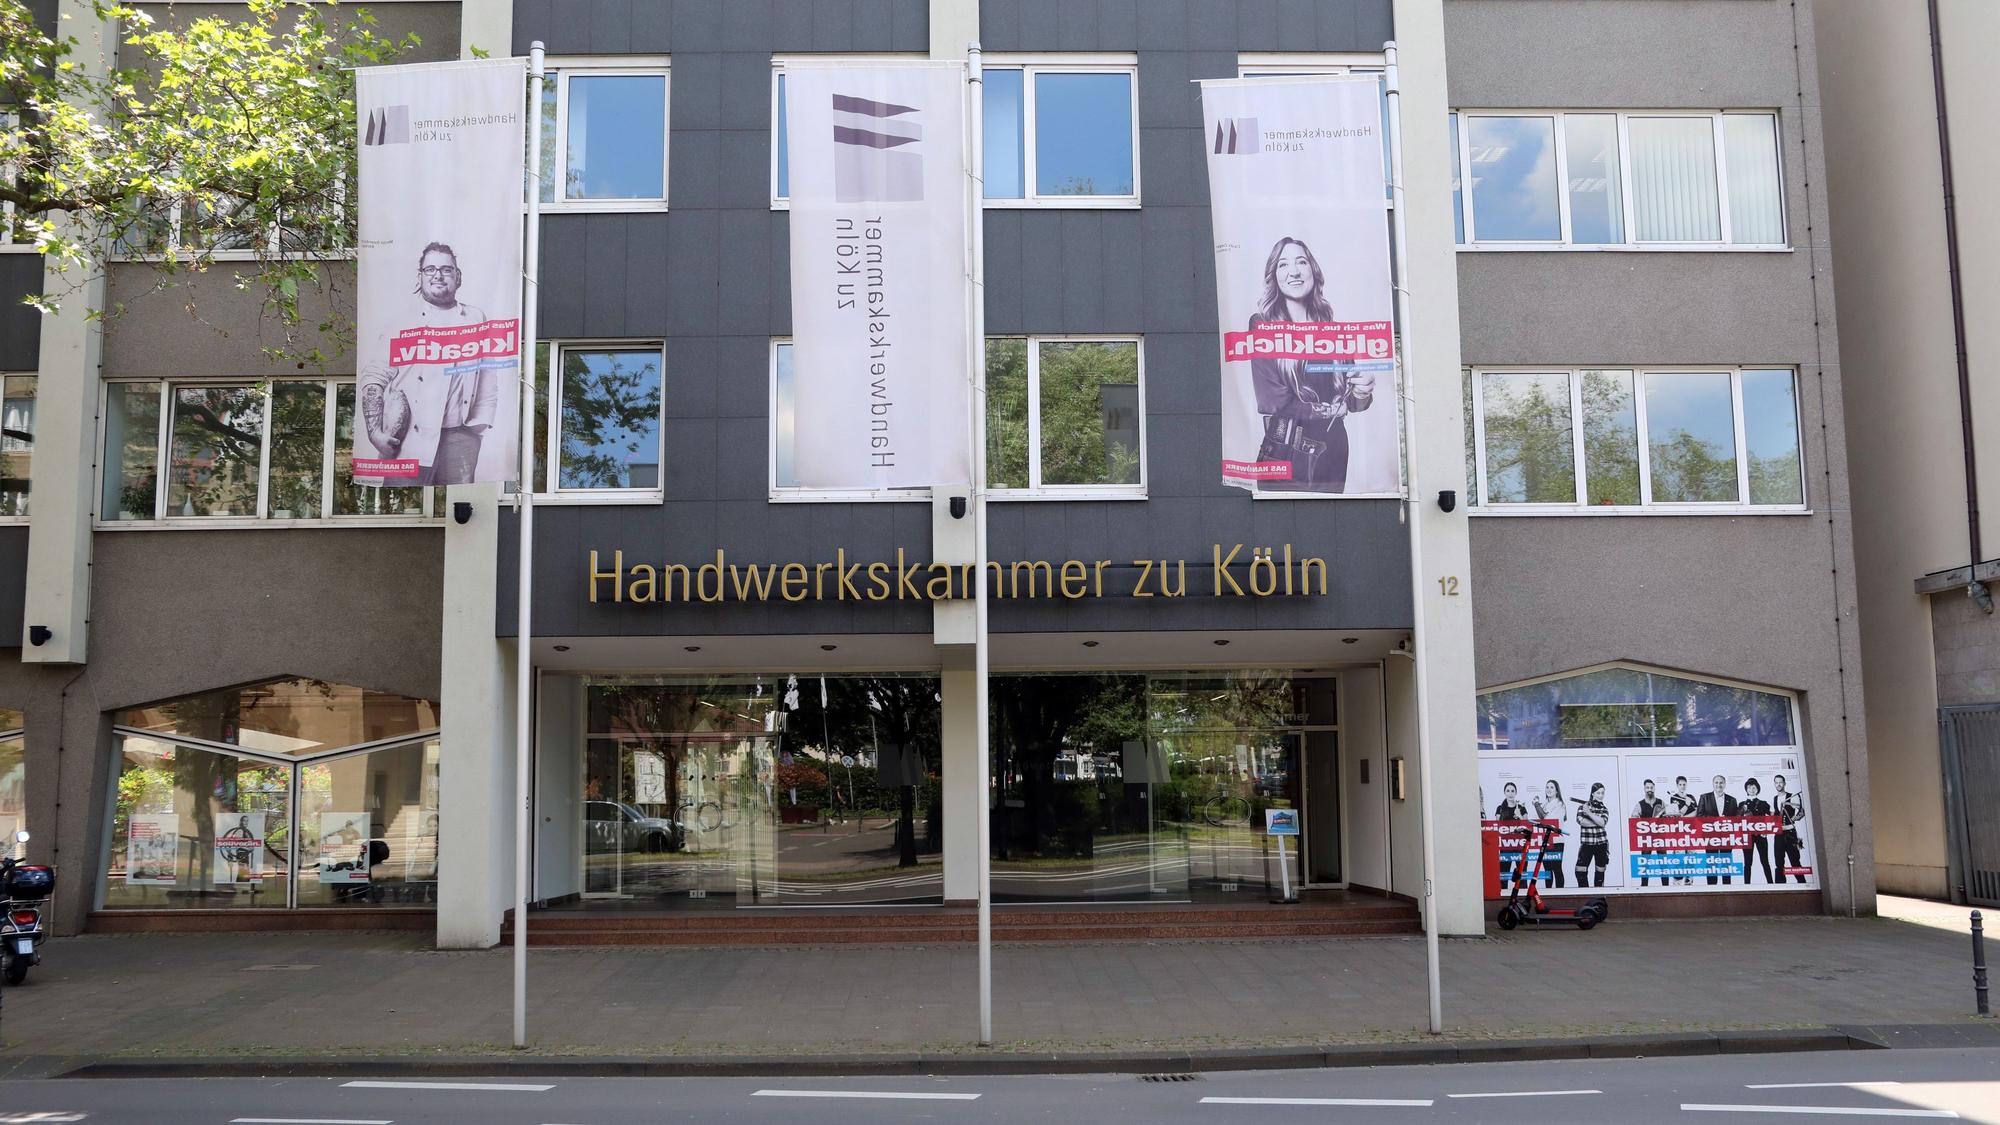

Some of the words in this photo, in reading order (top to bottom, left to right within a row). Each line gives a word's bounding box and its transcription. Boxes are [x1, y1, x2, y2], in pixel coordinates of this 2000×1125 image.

[589, 547, 1112, 603] Handwerkskammer
[1132, 559, 1186, 598] zu
[1213, 543, 1327, 597] Köln
[1438, 575, 1459, 596] 12
[1636, 820, 1697, 834] Stark,
[1701, 819, 1779, 834] stärker,
[1636, 834, 1749, 848] Handwerk!
[1637, 856, 1681, 866] Danke
[1683, 856, 1703, 865] für
[1705, 855, 1731, 864] den
[1637, 866, 1742, 876] Zusammenhalt.
